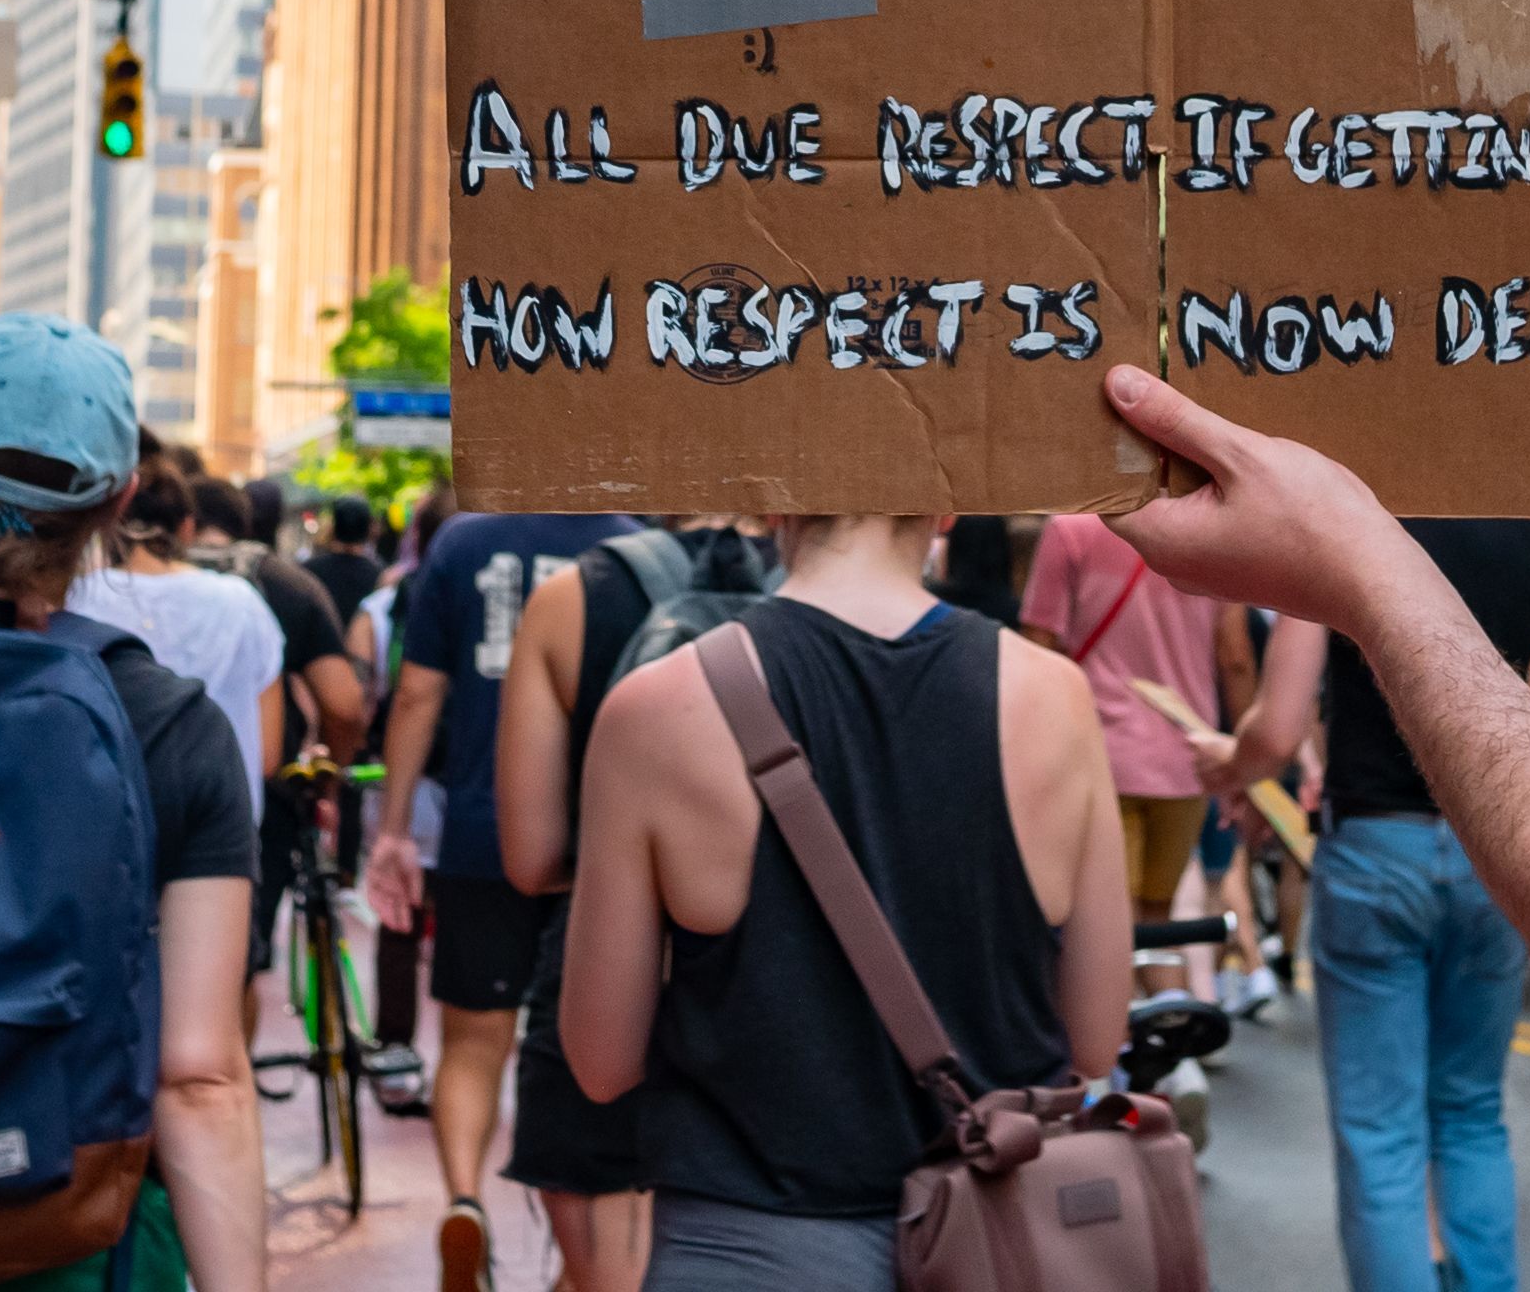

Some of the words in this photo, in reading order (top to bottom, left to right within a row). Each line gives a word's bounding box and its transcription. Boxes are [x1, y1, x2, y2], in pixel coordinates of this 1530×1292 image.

[460, 76, 638, 196] ALL
[674, 97, 825, 192] DUE
[875, 90, 1156, 197] RESPECT
[1174, 93, 1275, 192] IF
[457, 272, 616, 371] HOW
[644, 277, 985, 371] RESPECT
[1003, 280, 1105, 363] IS
[1177, 285, 1394, 376] NOW
